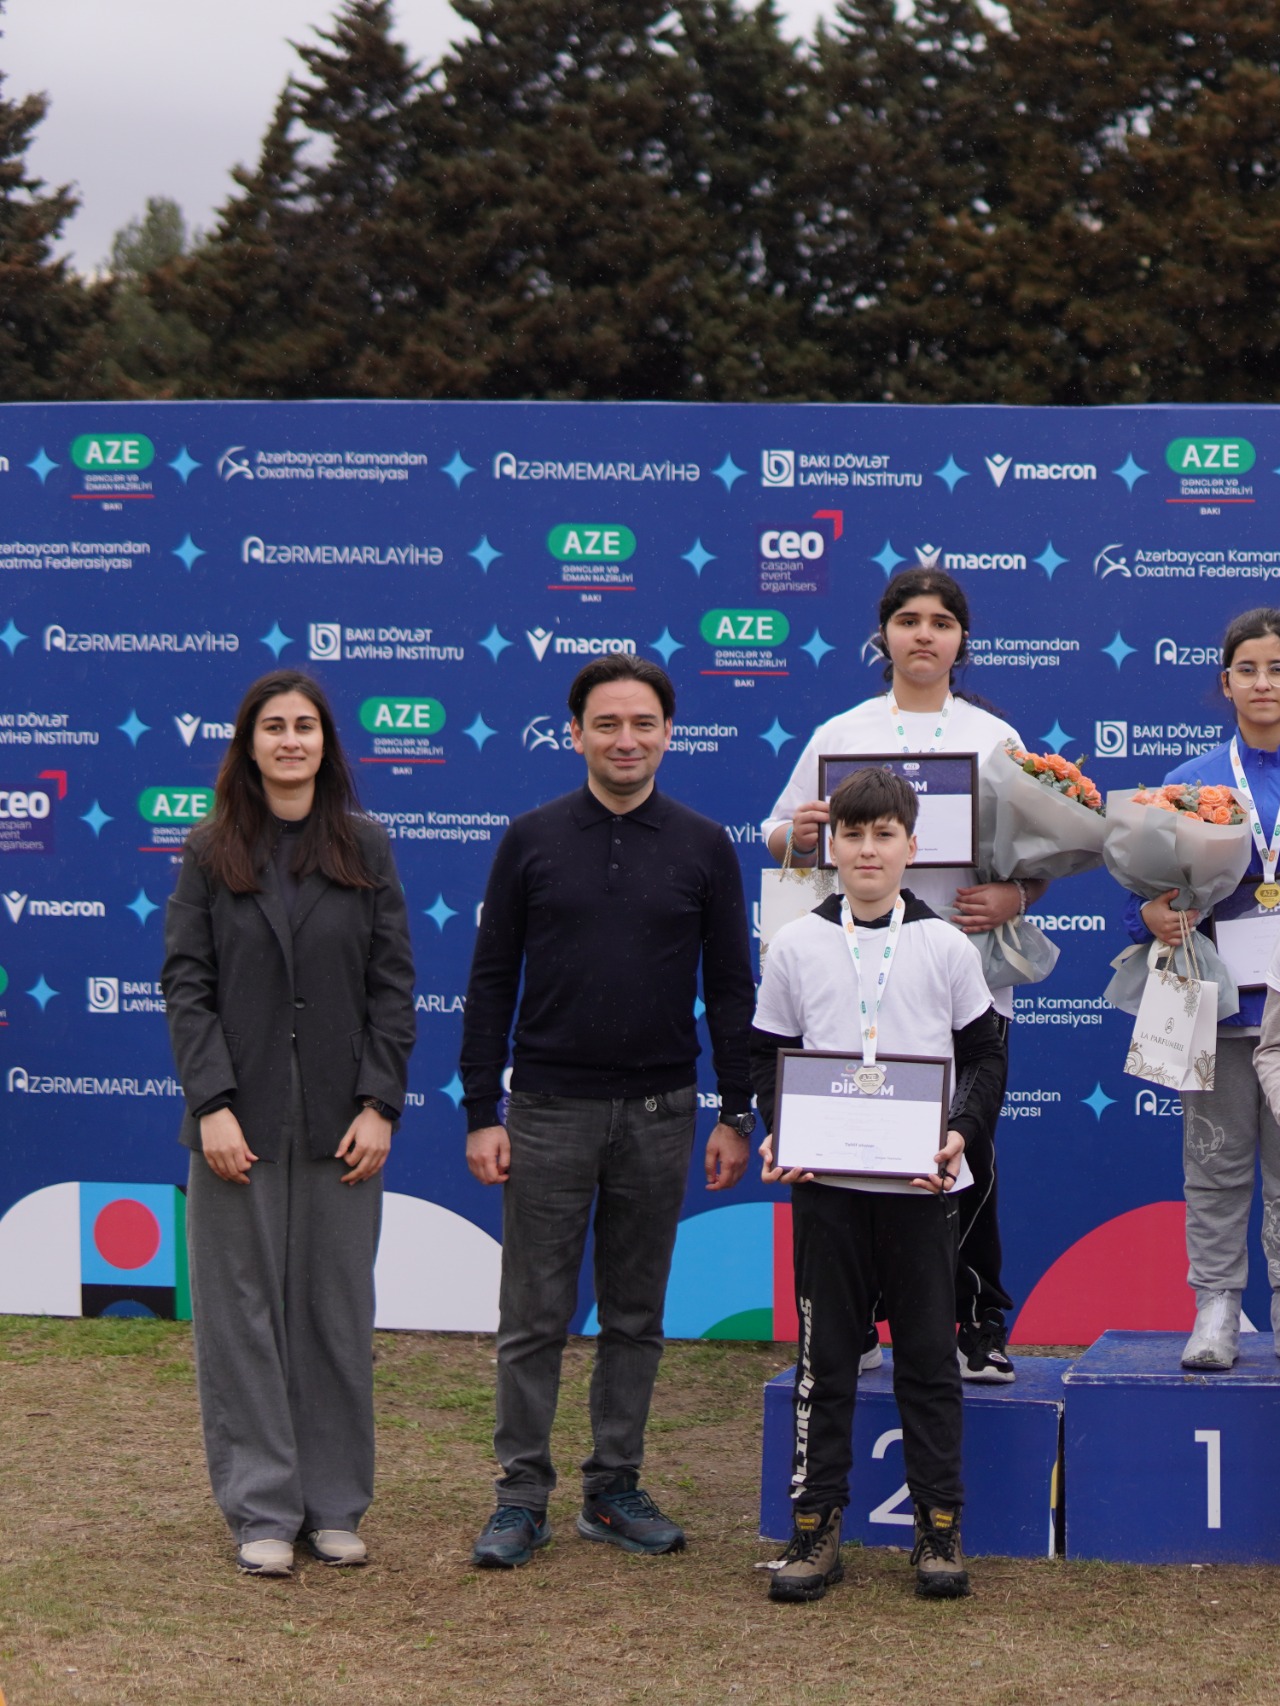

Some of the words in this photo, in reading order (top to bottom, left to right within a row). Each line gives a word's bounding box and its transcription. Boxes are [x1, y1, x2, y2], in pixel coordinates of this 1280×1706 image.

[85, 441, 140, 464] AZE
[256, 451, 343, 468] Azərbaycan
[345, 452, 427, 465] Kamandan
[800, 456, 829, 468] BAKI
[834, 453, 890, 469] DÖVLƏT
[1182, 444, 1239, 467] AZE
[256, 466, 315, 480] Oxatma
[317, 466, 409, 483] Federasiyası
[800, 470, 848, 485] LAYİHƏ
[852, 471, 922, 487] İNSTİTUTU
[1015, 463, 1096, 480] macron
[1200, 507, 1220, 515] BAKI
[0, 541, 69, 557] ərbaycan
[72, 541, 150, 554] Kamandan
[563, 531, 620, 555] AZE
[761, 531, 824, 559] ceo
[0, 556, 42, 569] xatma
[45, 555, 132, 572] Federasiyası
[944, 552, 1026, 570] macron
[1135, 549, 1224, 565] Azərbaycan
[761, 562, 804, 573] caspian
[1135, 564, 1195, 578] Oxatma
[761, 572, 791, 581] event
[761, 580, 817, 593] organisers
[346, 628, 374, 641] BAKI
[378, 625, 432, 642] DÖVLƏT
[715, 617, 773, 640] AZE
[346, 642, 393, 660] LAYİHƏ
[397, 644, 464, 660] İNSTİTUTU
[555, 636, 636, 656] macron
[995, 638, 1080, 651] Kamandan
[734, 679, 755, 687] BAKI
[18, 712, 69, 727] DÖVLƏT
[374, 704, 430, 728] AZE
[35, 730, 99, 745] İNSTİTUTU
[1133, 726, 1162, 738] BAKI
[1167, 723, 1223, 738] DÖVLƏT
[1133, 740, 1182, 755] LAYİHƏ
[153, 794, 207, 817] AZE
[428, 812, 510, 826] Kamandan
[400, 826, 491, 844] Federasiyası
[29, 901, 105, 917] macron
[1029, 915, 1105, 931] macron
[123, 982, 151, 995] BAKI
[1014, 1011, 1102, 1027] ederasiyası
[8, 1066, 185, 1096] AZƏRMEMARLAYİH
[869, 1428, 917, 1526] 2
[1195, 1430, 1221, 1529] 1
